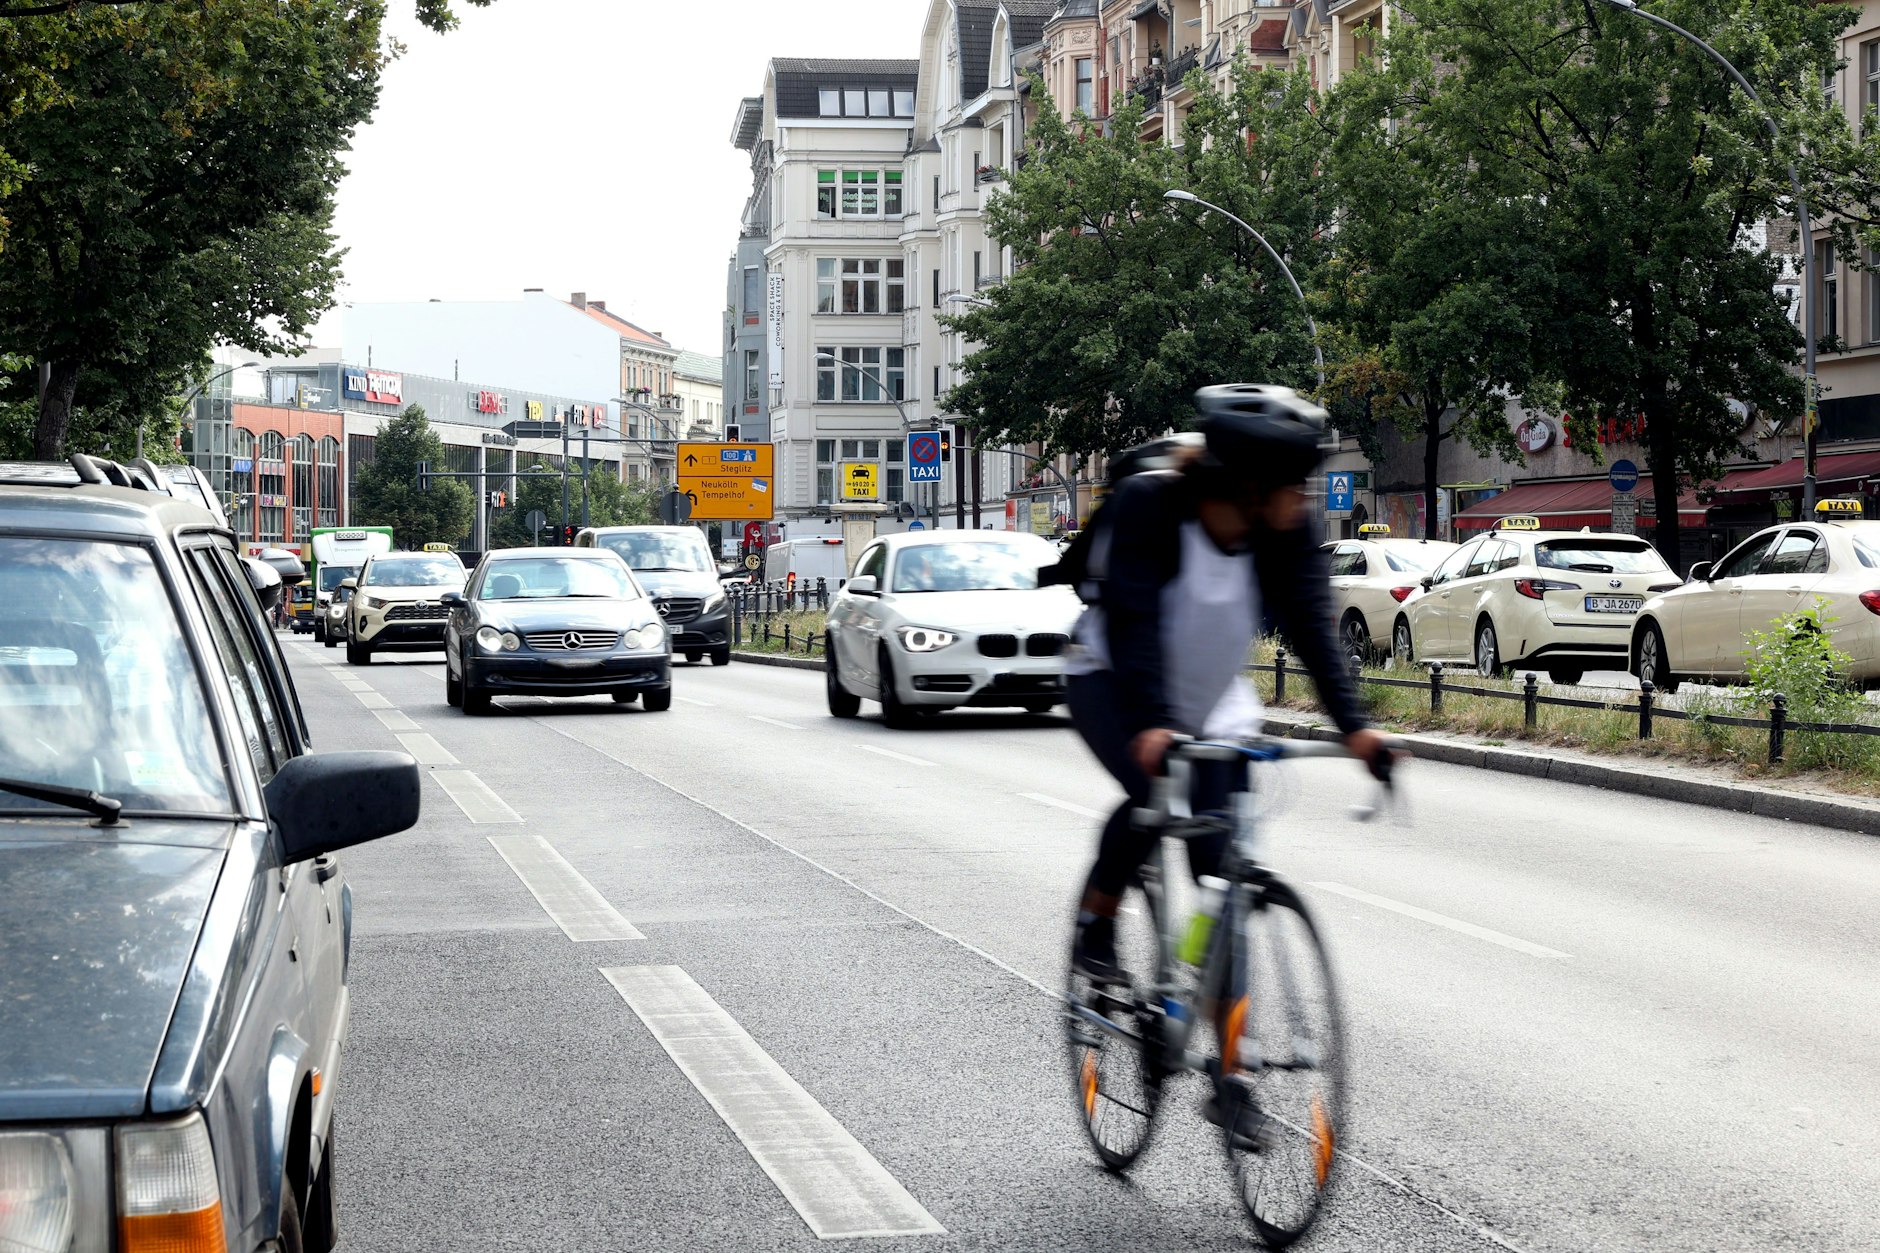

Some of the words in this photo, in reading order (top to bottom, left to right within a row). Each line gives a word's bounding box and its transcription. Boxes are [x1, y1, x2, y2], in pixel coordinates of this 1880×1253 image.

[348, 375, 367, 392] KIND
[721, 465, 752, 474] Steglitz
[912, 466, 939, 478] TAXI
[702, 491, 745, 499] Tempelhof
[1830, 501, 1857, 510] TAXI
[1592, 600, 1598, 608] B
[1604, 600, 1616, 609] JA
[1618, 600, 1641, 609] 2670
